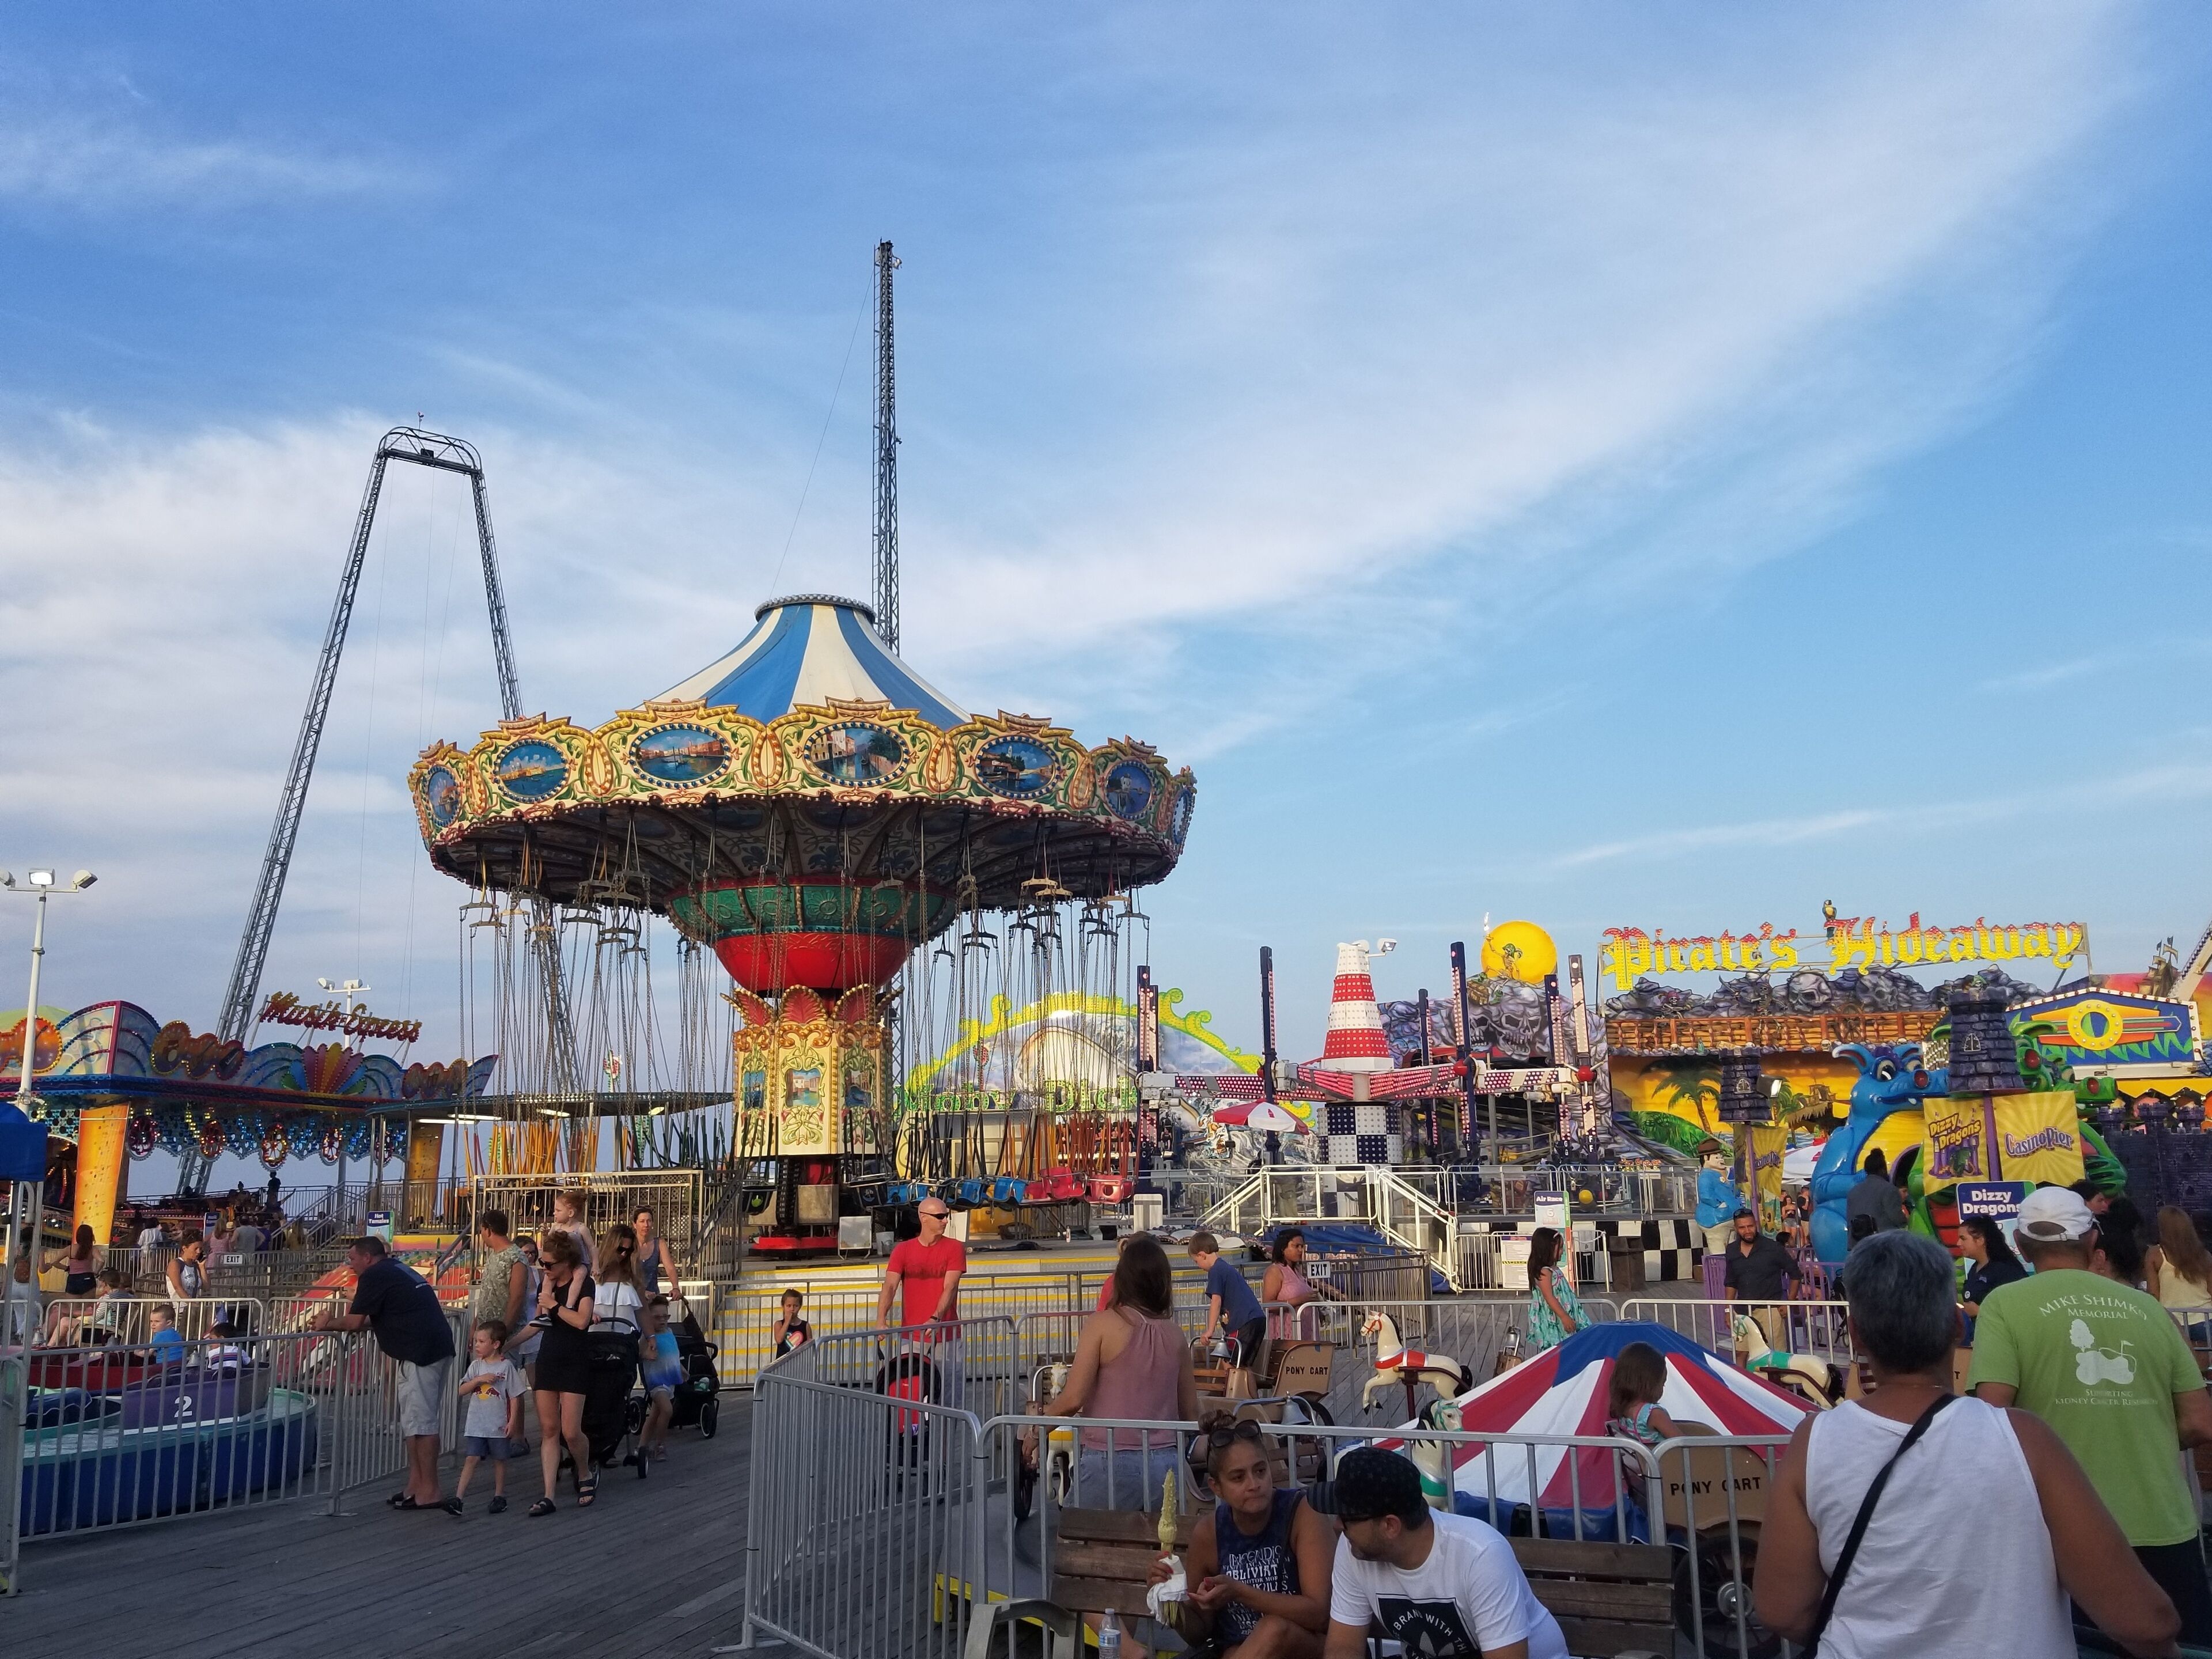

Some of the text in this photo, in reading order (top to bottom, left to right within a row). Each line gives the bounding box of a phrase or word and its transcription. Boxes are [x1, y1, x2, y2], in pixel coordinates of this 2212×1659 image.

[1603, 912, 2082, 991] Pirate's Hideaway
[1930, 1114, 1959, 1135] Dizzy
[1939, 1121, 1981, 1150] Dragons
[1972, 1189, 2012, 1203] Dizzy
[226, 1255, 240, 1263] EXIT
[1311, 1264, 1327, 1276] EXIT
[2039, 1295, 2079, 1317] MIKE
[2067, 1308, 2129, 1319] MEMORIAL
[1286, 1366, 1328, 1375] PONY CART
[174, 1396, 192, 1418] 2
[1721, 1476, 1761, 1492] CART
[1425, 1613, 1453, 1637] WITH
[1455, 1637, 1469, 1653] TH
